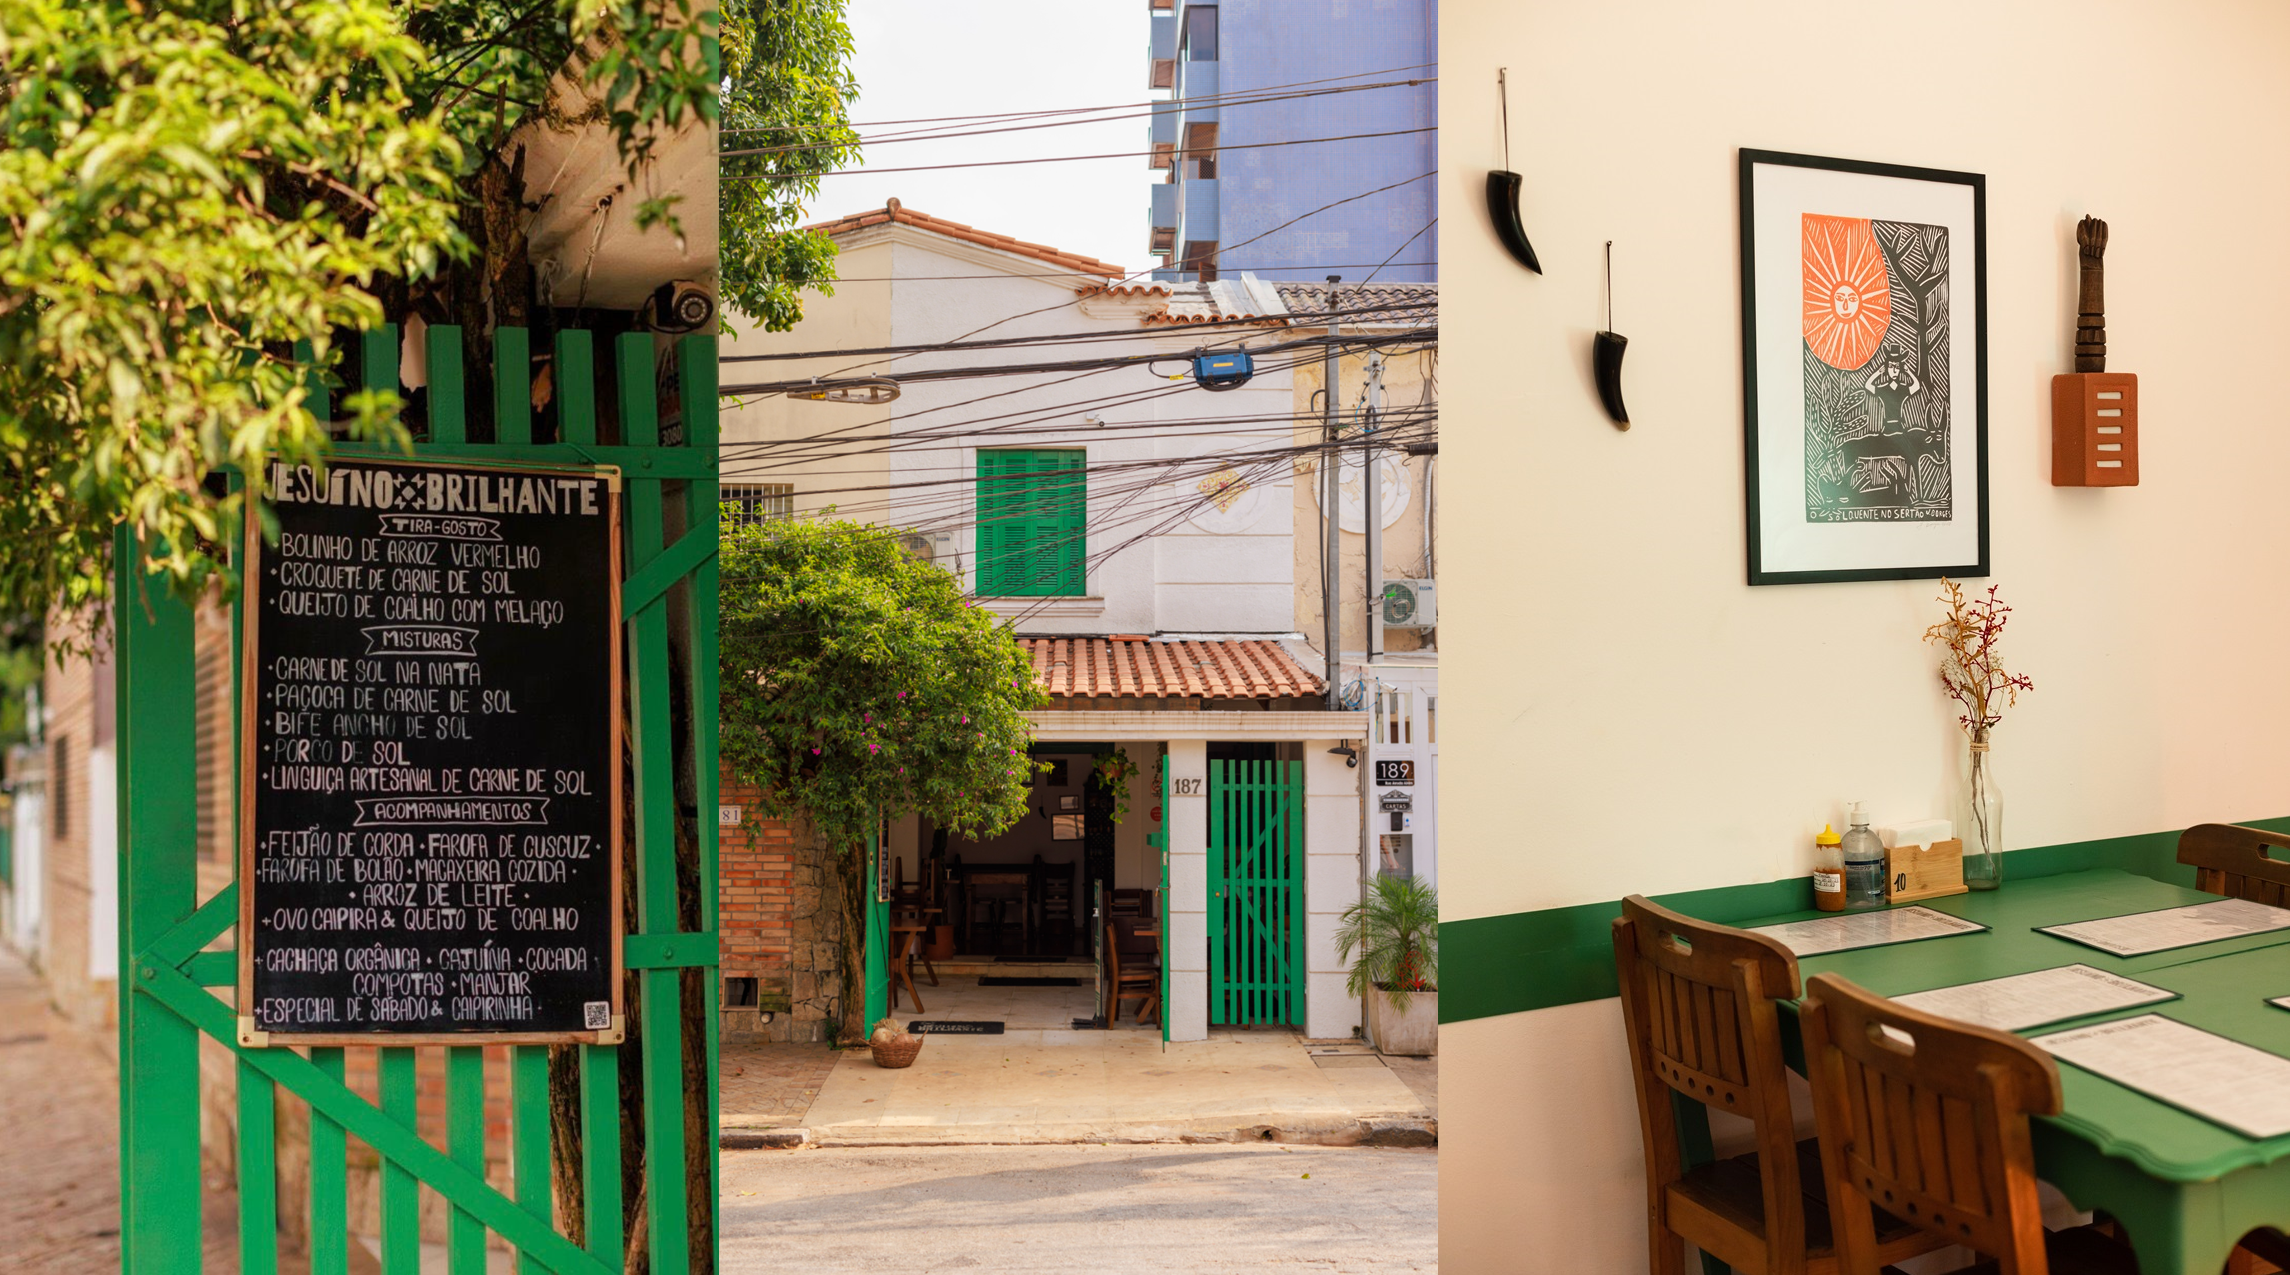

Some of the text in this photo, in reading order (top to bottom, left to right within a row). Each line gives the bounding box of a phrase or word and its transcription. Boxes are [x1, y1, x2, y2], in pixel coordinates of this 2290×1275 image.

[426, 473, 599, 515] BRILHANTE
[392, 518, 487, 537] TIRA-GOSTO
[1881, 510, 1892, 519] NO
[282, 532, 540, 569] BOLINHO DE ARROZ VERMELHO
[280, 561, 516, 594] CROQUETE DE CARNE DE SOL
[279, 590, 348, 618] QUEIJO
[354, 595, 376, 618] DE
[452, 598, 486, 622] COM
[495, 599, 564, 629] MELAÇO
[382, 630, 463, 650] MISTURAS
[276, 656, 481, 686] CARNE DE SOL NA NATA
[276, 683, 518, 714] PAÇOCA DE CARNE DE SOL
[275, 712, 472, 740] BIFE ANCHO DE SOL
[274, 738, 411, 766] PORCO DE SOL
[271, 765, 592, 796] LINGUIÇA ARTESANAL DE CARNE DE SOL
[1380, 762, 1410, 778] 189
[1174, 778, 1202, 794] 187
[374, 802, 532, 821] ACOMPANHAMENTOS
[268, 823, 592, 859] FEIJÃO DE CORDA FAROFA DE CUSCUZ
[262, 856, 566, 883] FAROFA DE BOLÃO MACAXEIRA COZIDA
[1894, 872, 1907, 892] 10
[363, 883, 517, 907] ARROZ DE LEITE
[312, 906, 378, 930] CAIPIRA
[380, 910, 396, 928] &
[404, 908, 466, 932] QUEIJO
[478, 908, 498, 931] DE
[512, 908, 579, 932] COALHO
[266, 948, 338, 974] CACHAÇA
[344, 942, 420, 972] ORGÂNICA
[439, 939, 512, 971] CAJUÍNA
[526, 947, 588, 972] COCADA
[353, 971, 532, 996] COMPOTAS MANJAR
[347, 997, 364, 1022] DE
[370, 994, 428, 1022] SÁBADO
[430, 1000, 444, 1017] &
[452, 996, 534, 1021] CAIPIRINHA
